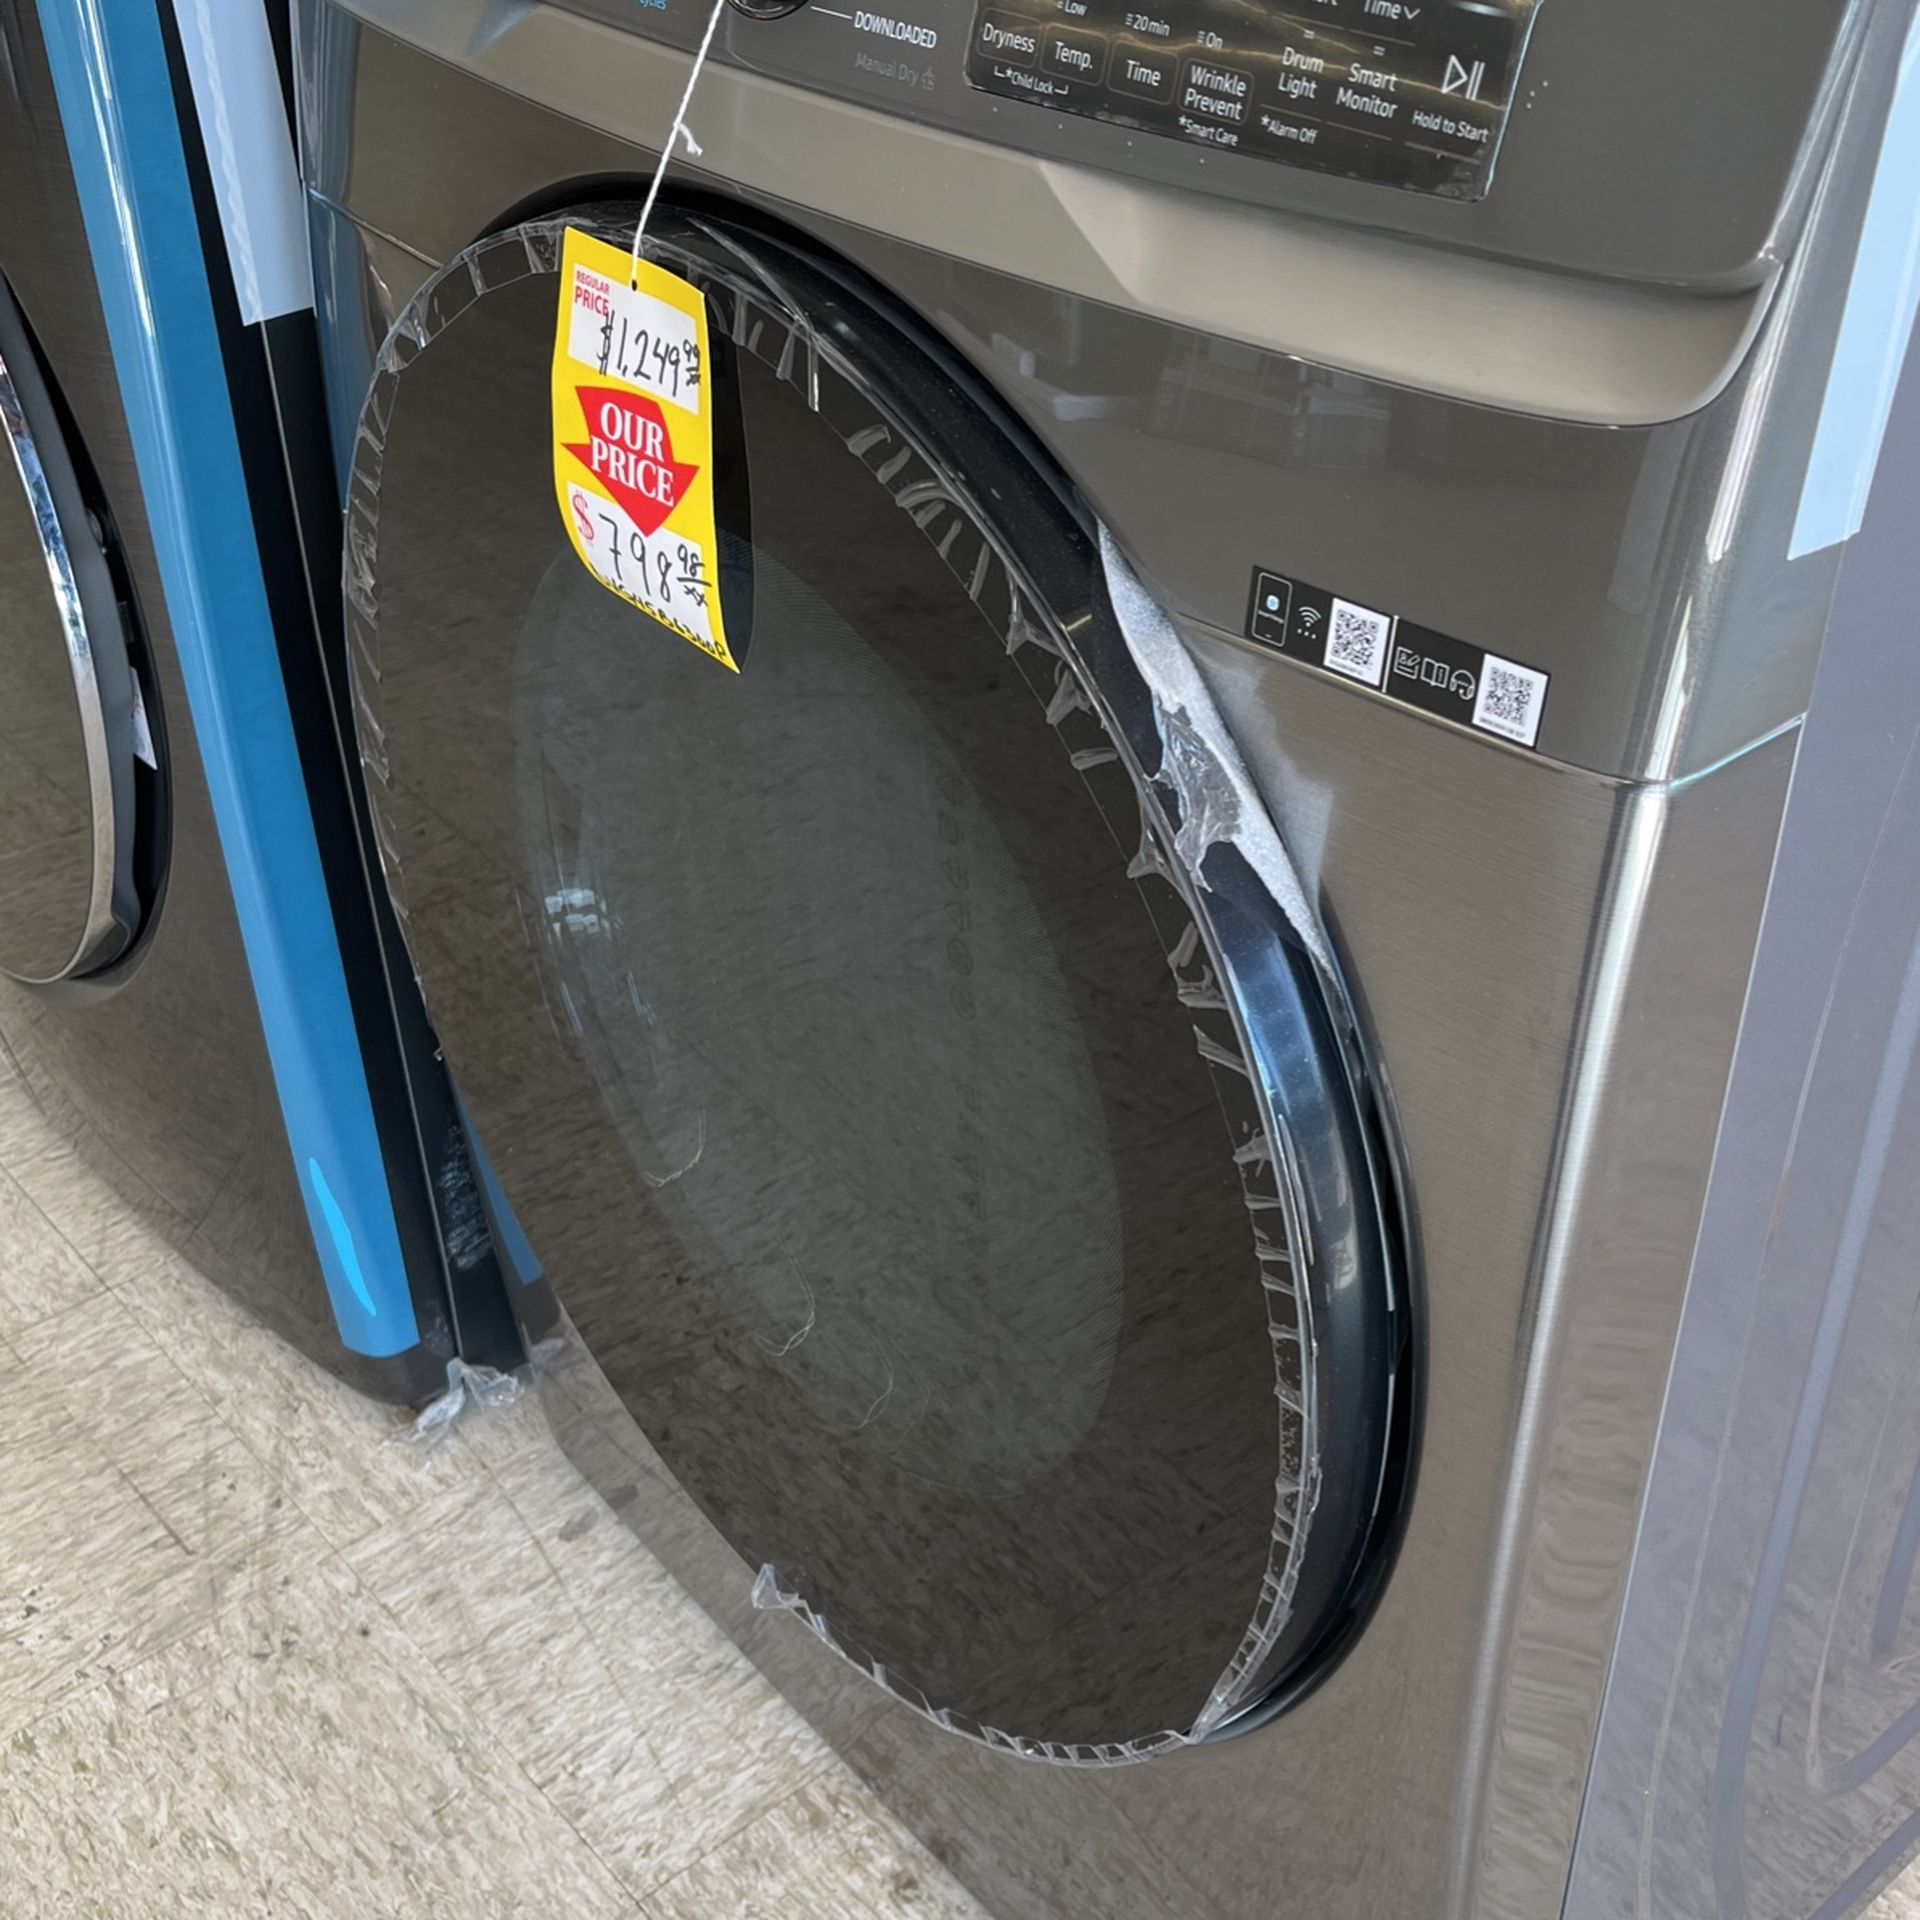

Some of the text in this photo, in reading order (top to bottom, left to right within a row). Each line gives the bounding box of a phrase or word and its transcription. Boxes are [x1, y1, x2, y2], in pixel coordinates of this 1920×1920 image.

[1064, 0, 1087, 17] Low
[1363, 0, 1400, 19] Time
[854, 11, 937, 49] DOWNLOADED
[982, 23, 1036, 54] Dryness
[1205, 32, 1224, 50] On
[855, 52, 919, 87] Manual Dry
[1055, 41, 1093, 69] Temp.
[1282, 46, 1324, 74] Drum
[1126, 59, 1161, 86] Time
[1191, 65, 1247, 97] Wrinkle
[1278, 72, 1317, 99] Light
[1348, 63, 1397, 92] Smart
[1184, 87, 1243, 120] Prevent
[1336, 87, 1397, 119] Monitor
[1216, 127, 1239, 146] Care
[1299, 127, 1318, 144] Off
[1412, 110, 1490, 143] Hold to Start
[576, 270, 610, 294] REGULAR
[575, 286, 609, 316] PRICE
[600, 402, 664, 462] OUR
[591, 434, 674, 507] PRICE
